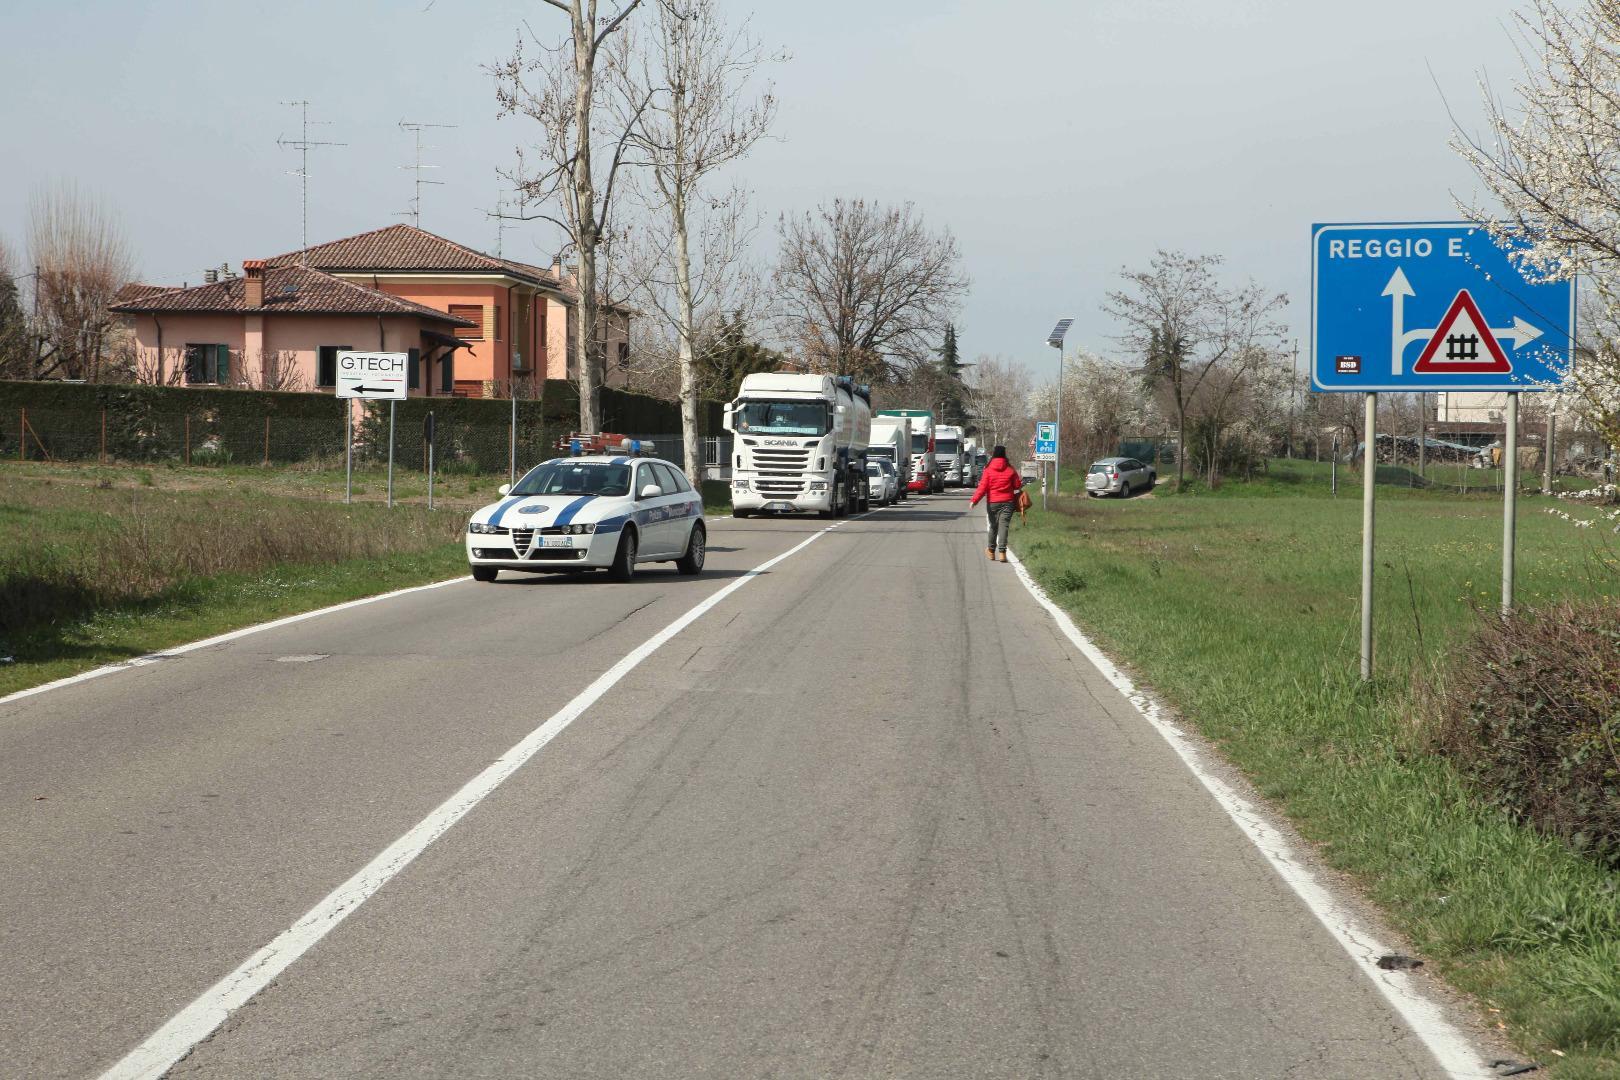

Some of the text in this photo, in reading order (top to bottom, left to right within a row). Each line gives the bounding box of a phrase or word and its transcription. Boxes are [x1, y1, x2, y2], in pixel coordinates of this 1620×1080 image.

[1329, 238, 1433, 259] REGGIO
[340, 356, 404, 371] G.TECH
[764, 439, 799, 447] SCANIA
[1040, 443, 1054, 453] eni
